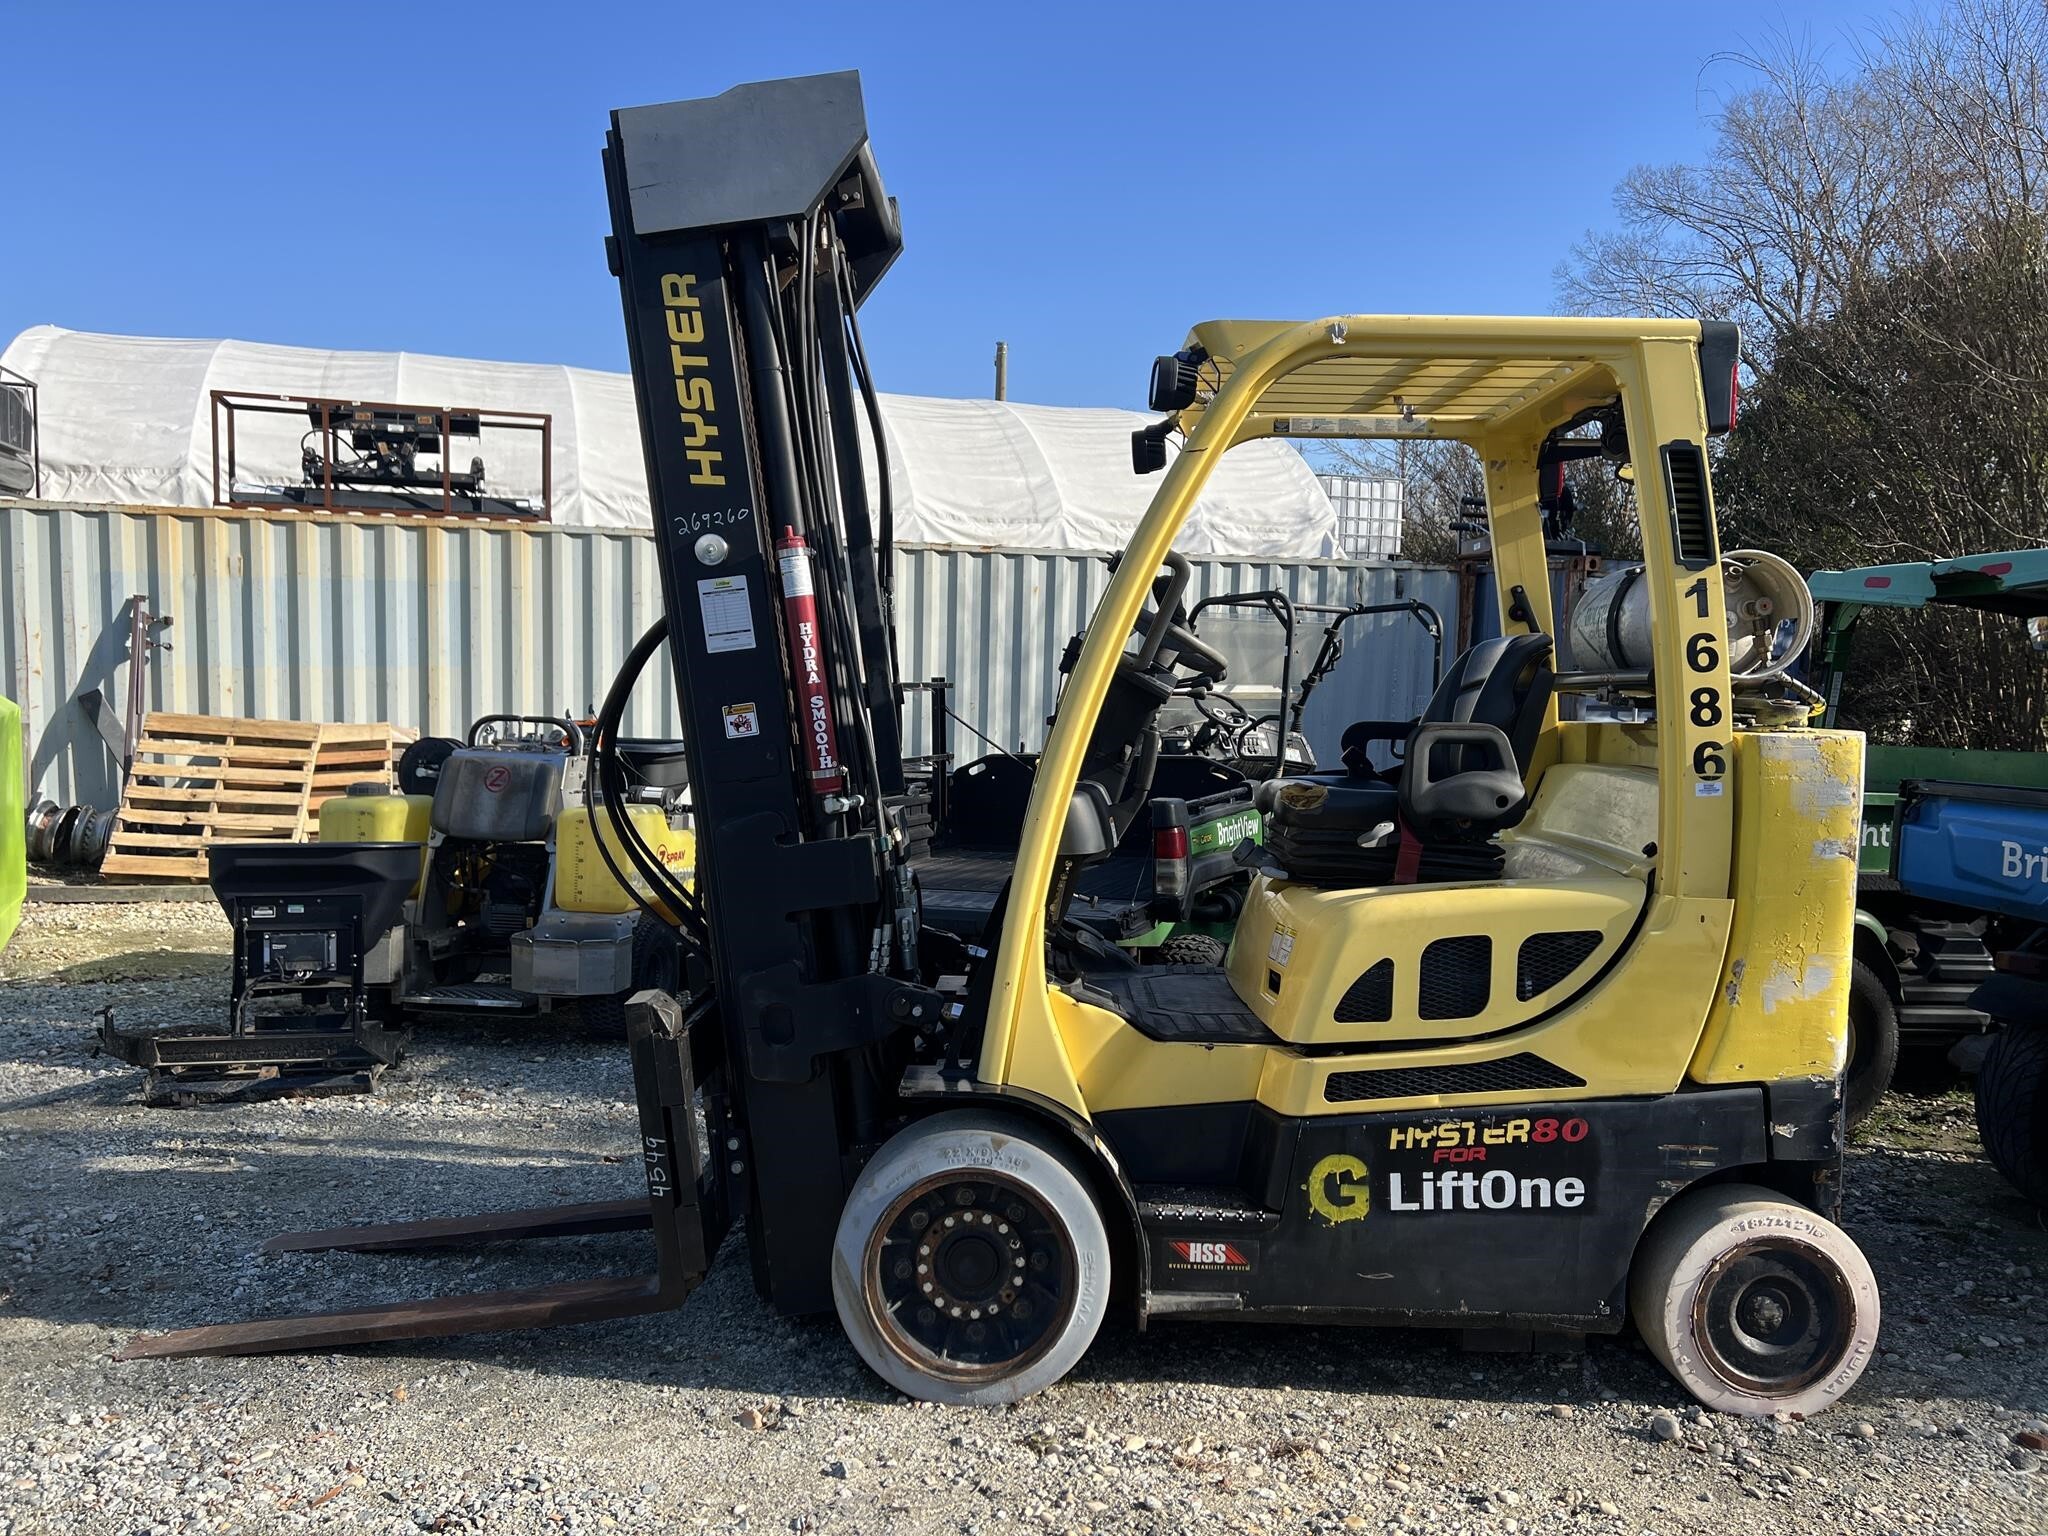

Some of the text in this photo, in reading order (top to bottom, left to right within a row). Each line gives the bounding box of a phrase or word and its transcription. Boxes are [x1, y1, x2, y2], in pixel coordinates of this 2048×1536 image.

[660, 273, 726, 486] HYSTER
[674, 508, 749, 535] 269260
[798, 622, 834, 769] HYDRA SMOOTH
[1216, 815, 1259, 847] BrightView
[667, 849, 686, 864] SPRAY
[646, 1136, 672, 1197] 4549
[1432, 1147, 1487, 1164] FOR
[1305, 1153, 1371, 1226] G
[1389, 1169, 1586, 1211] LiftOne
[1189, 1242, 1227, 1264] HSS
